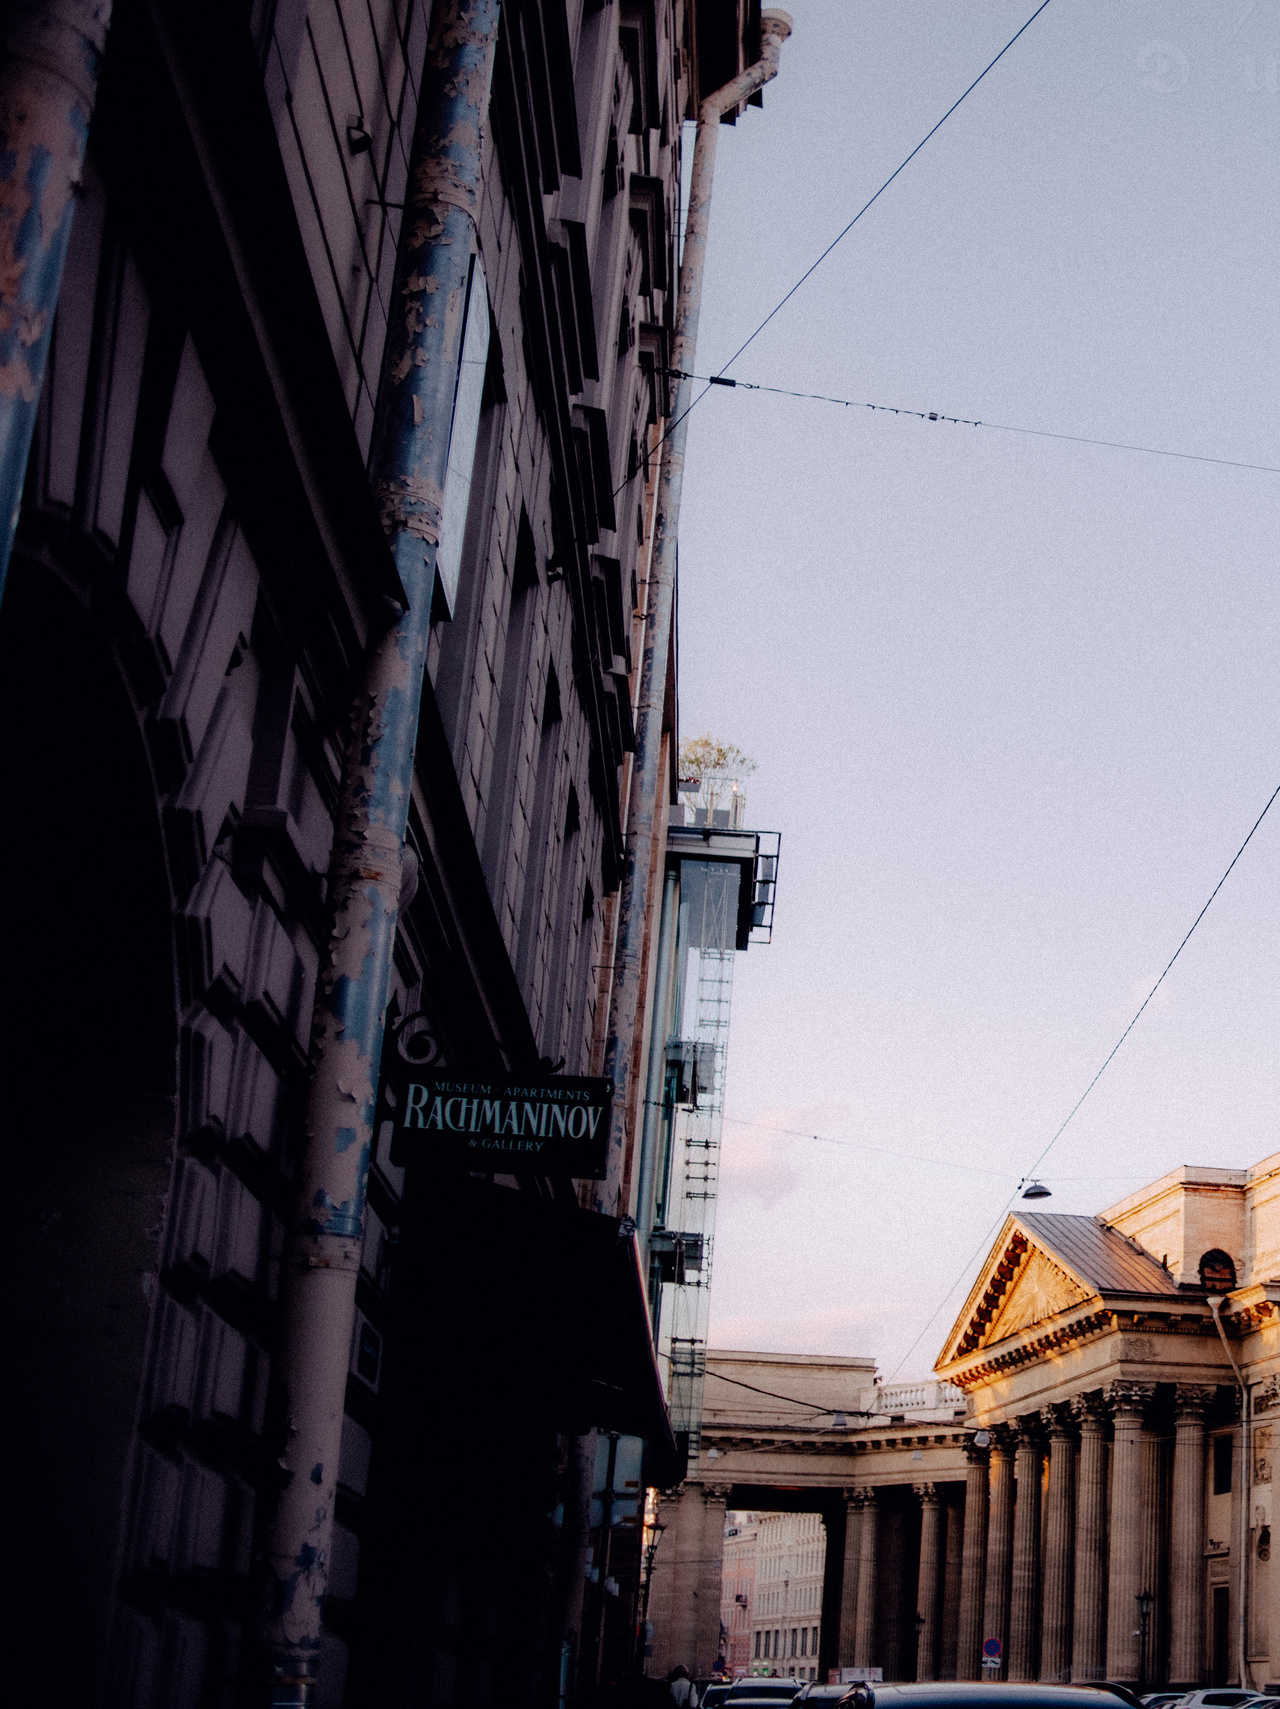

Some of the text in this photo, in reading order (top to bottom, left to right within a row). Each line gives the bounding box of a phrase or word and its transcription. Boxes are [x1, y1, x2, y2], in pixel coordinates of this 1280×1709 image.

[434, 1081, 590, 1102] MUSEUM APARTMENTS
[402, 1083, 604, 1140] RACHMANINOV
[468, 1138, 544, 1152] & GALLERY
